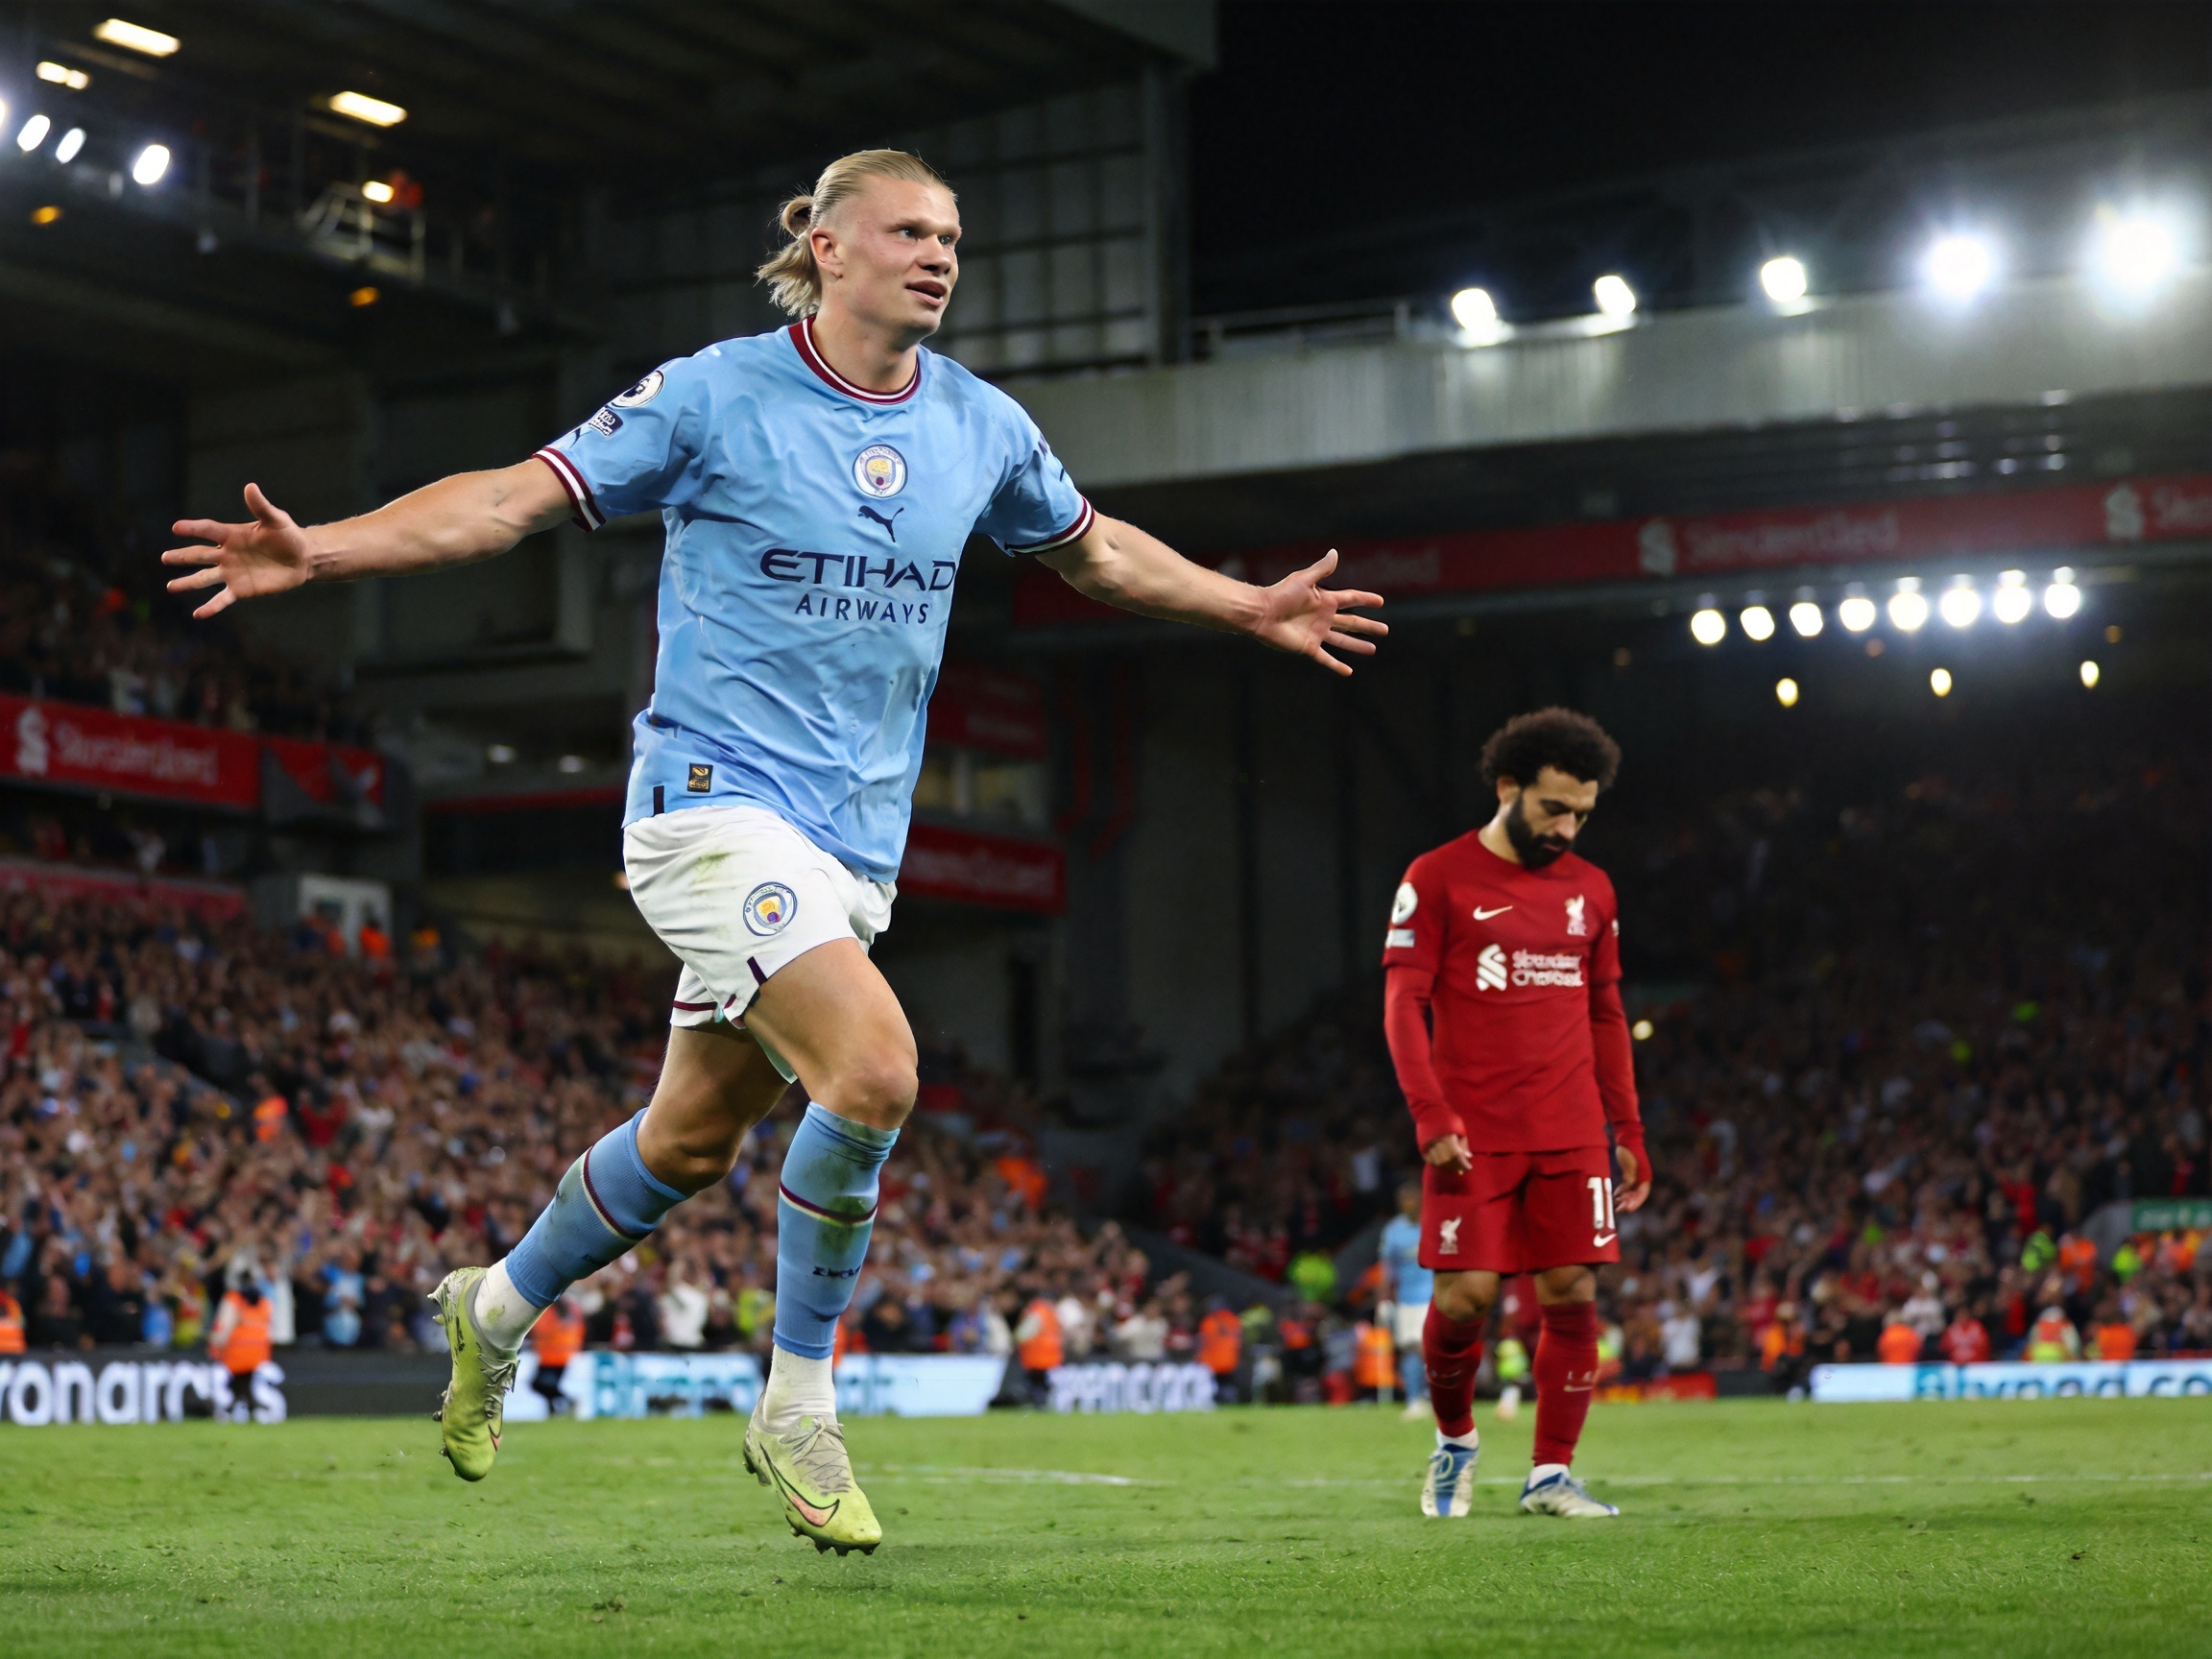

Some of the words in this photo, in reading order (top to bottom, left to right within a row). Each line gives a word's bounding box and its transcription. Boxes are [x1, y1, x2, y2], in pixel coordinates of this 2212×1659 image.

[759, 548, 957, 591] ETIHAD
[794, 593, 929, 624] AIRWAYS
[1587, 1176, 1616, 1229] 11
